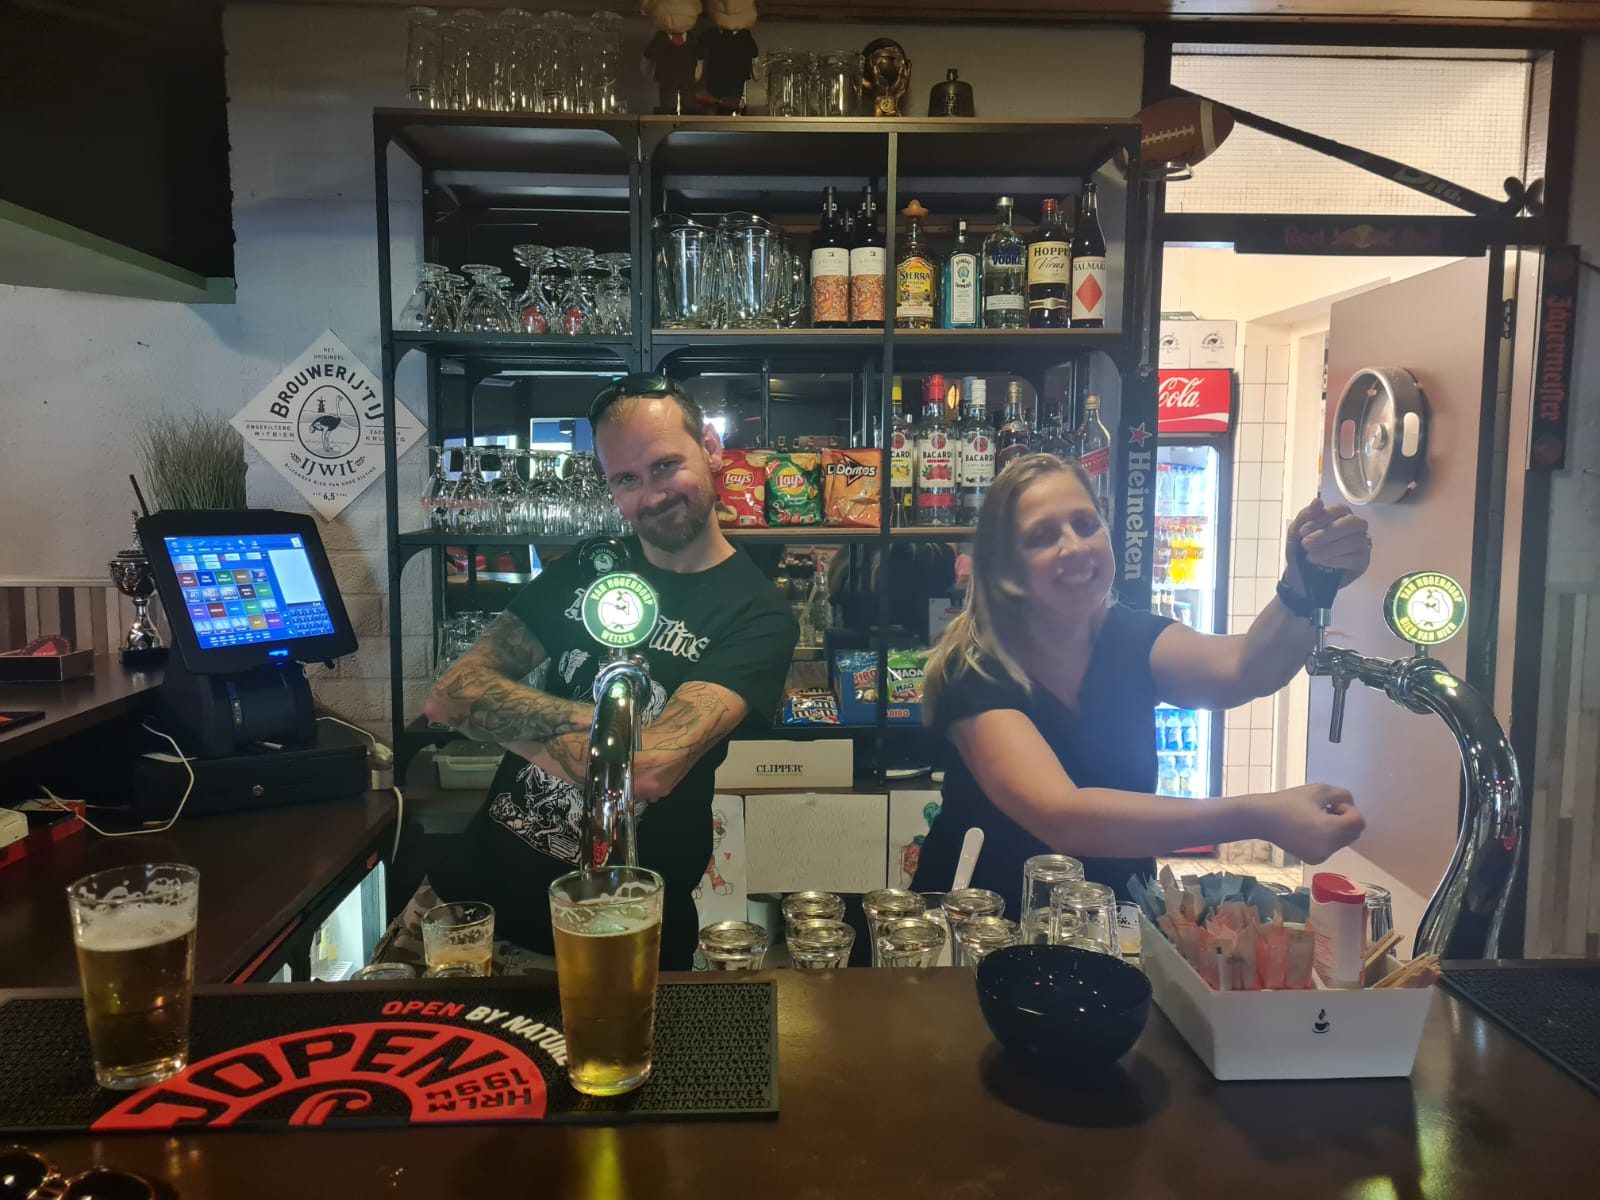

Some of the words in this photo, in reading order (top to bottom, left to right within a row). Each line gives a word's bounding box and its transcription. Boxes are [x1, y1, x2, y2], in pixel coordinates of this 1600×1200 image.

[900, 271, 930, 280] SIERRA
[836, 463, 875, 477] Doritos
[1124, 450, 1152, 581] Heineken
[590, 583, 608, 600] VAN
[1400, 582, 1417, 599] VAN
[601, 629, 636, 644] WEIZEN
[382, 1000, 465, 1019] OPEN
[465, 1005, 509, 1024] BY
[428, 1087, 532, 1113] HRLM
